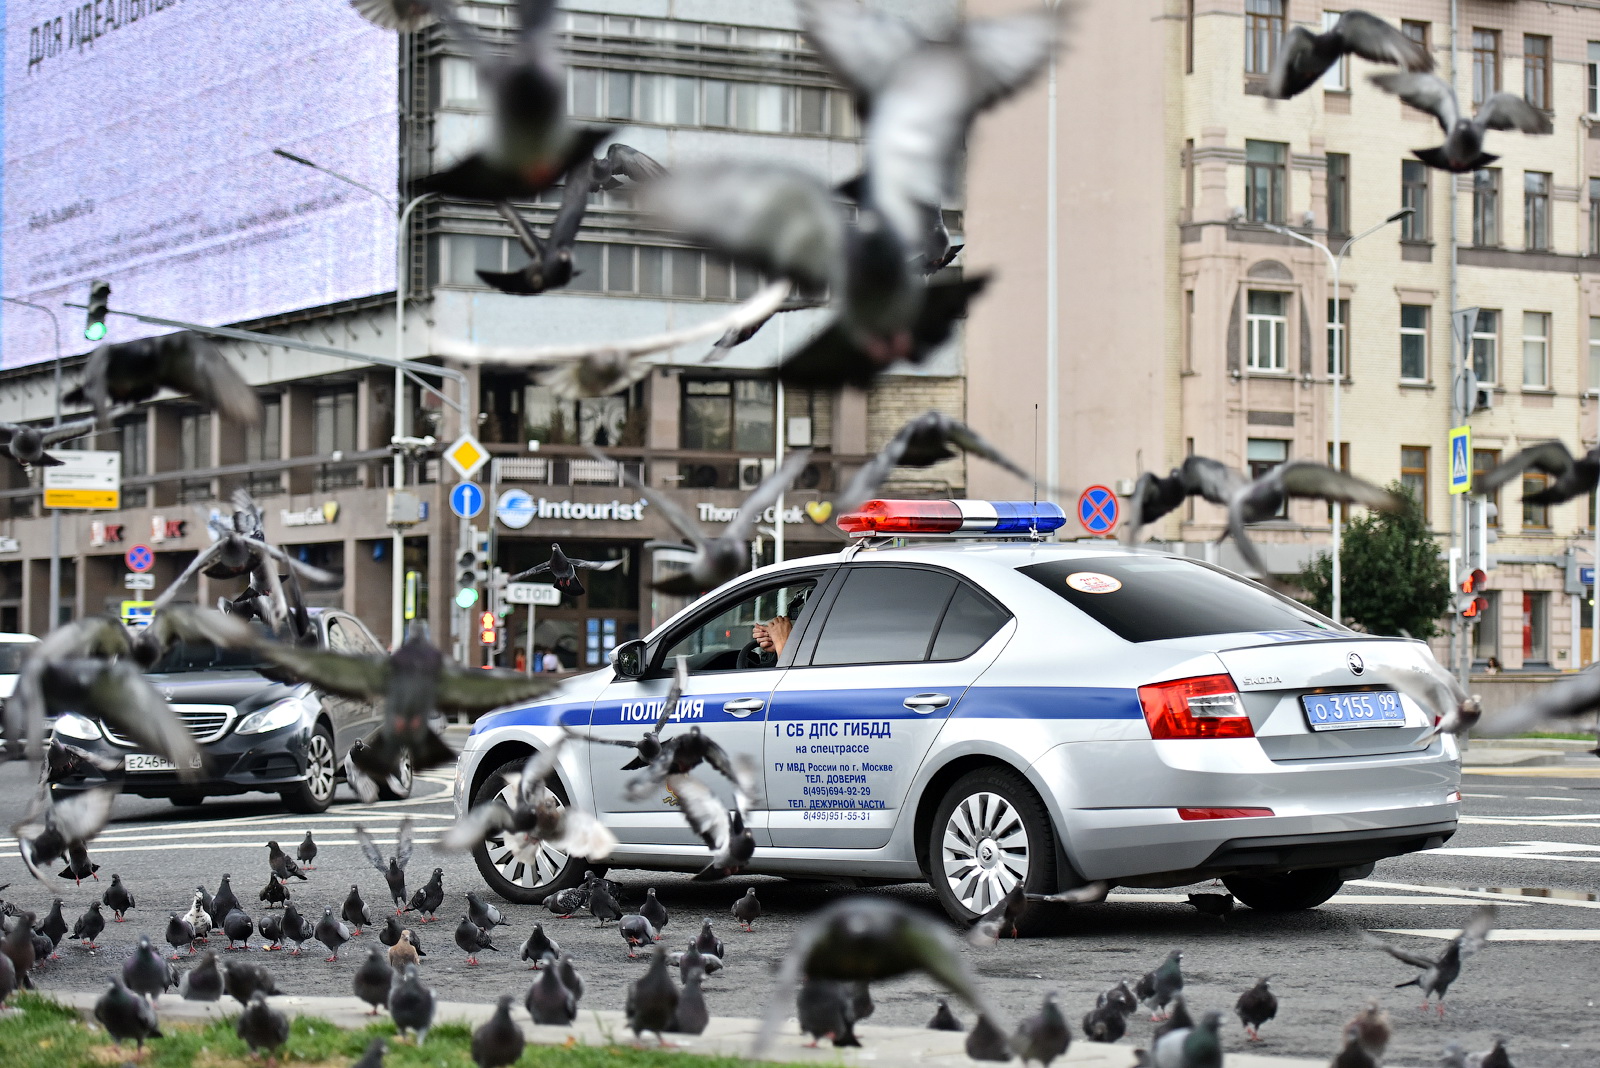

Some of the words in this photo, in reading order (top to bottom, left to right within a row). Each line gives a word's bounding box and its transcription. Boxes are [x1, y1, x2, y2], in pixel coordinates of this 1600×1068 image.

[538, 498, 645, 520] Intourist
[514, 587, 553, 600] СТОП
[1330, 696, 1374, 720] 3155
[1378, 694, 1395, 711] 99
[775, 723, 780, 737] 1
[786, 723, 805, 737] СБ
[809, 722, 839, 740] ДПС
[843, 722, 892, 739] ГИБДД
[795, 745, 807, 754] на
[810, 744, 870, 756] спецтрассе
[775, 763, 784, 772] ГУ
[787, 763, 806, 774] МВД
[808, 763, 837, 772] России
[840, 764, 850, 772] по
[853, 764, 859, 772] г.
[862, 762, 893, 772] Москве
[805, 775, 825, 784] ТЕЛ.
[827, 774, 867, 785] ДОВЕРИЯ
[803, 786, 871, 797] 8(495)694-92-29
[788, 799, 807, 809] ТЕЛ.
[810, 798, 856, 810] ДЕЖУРНОЙ
[859, 800, 886, 809] ЧАСТИ
[803, 811, 871, 821] 8(495)951-55-31
